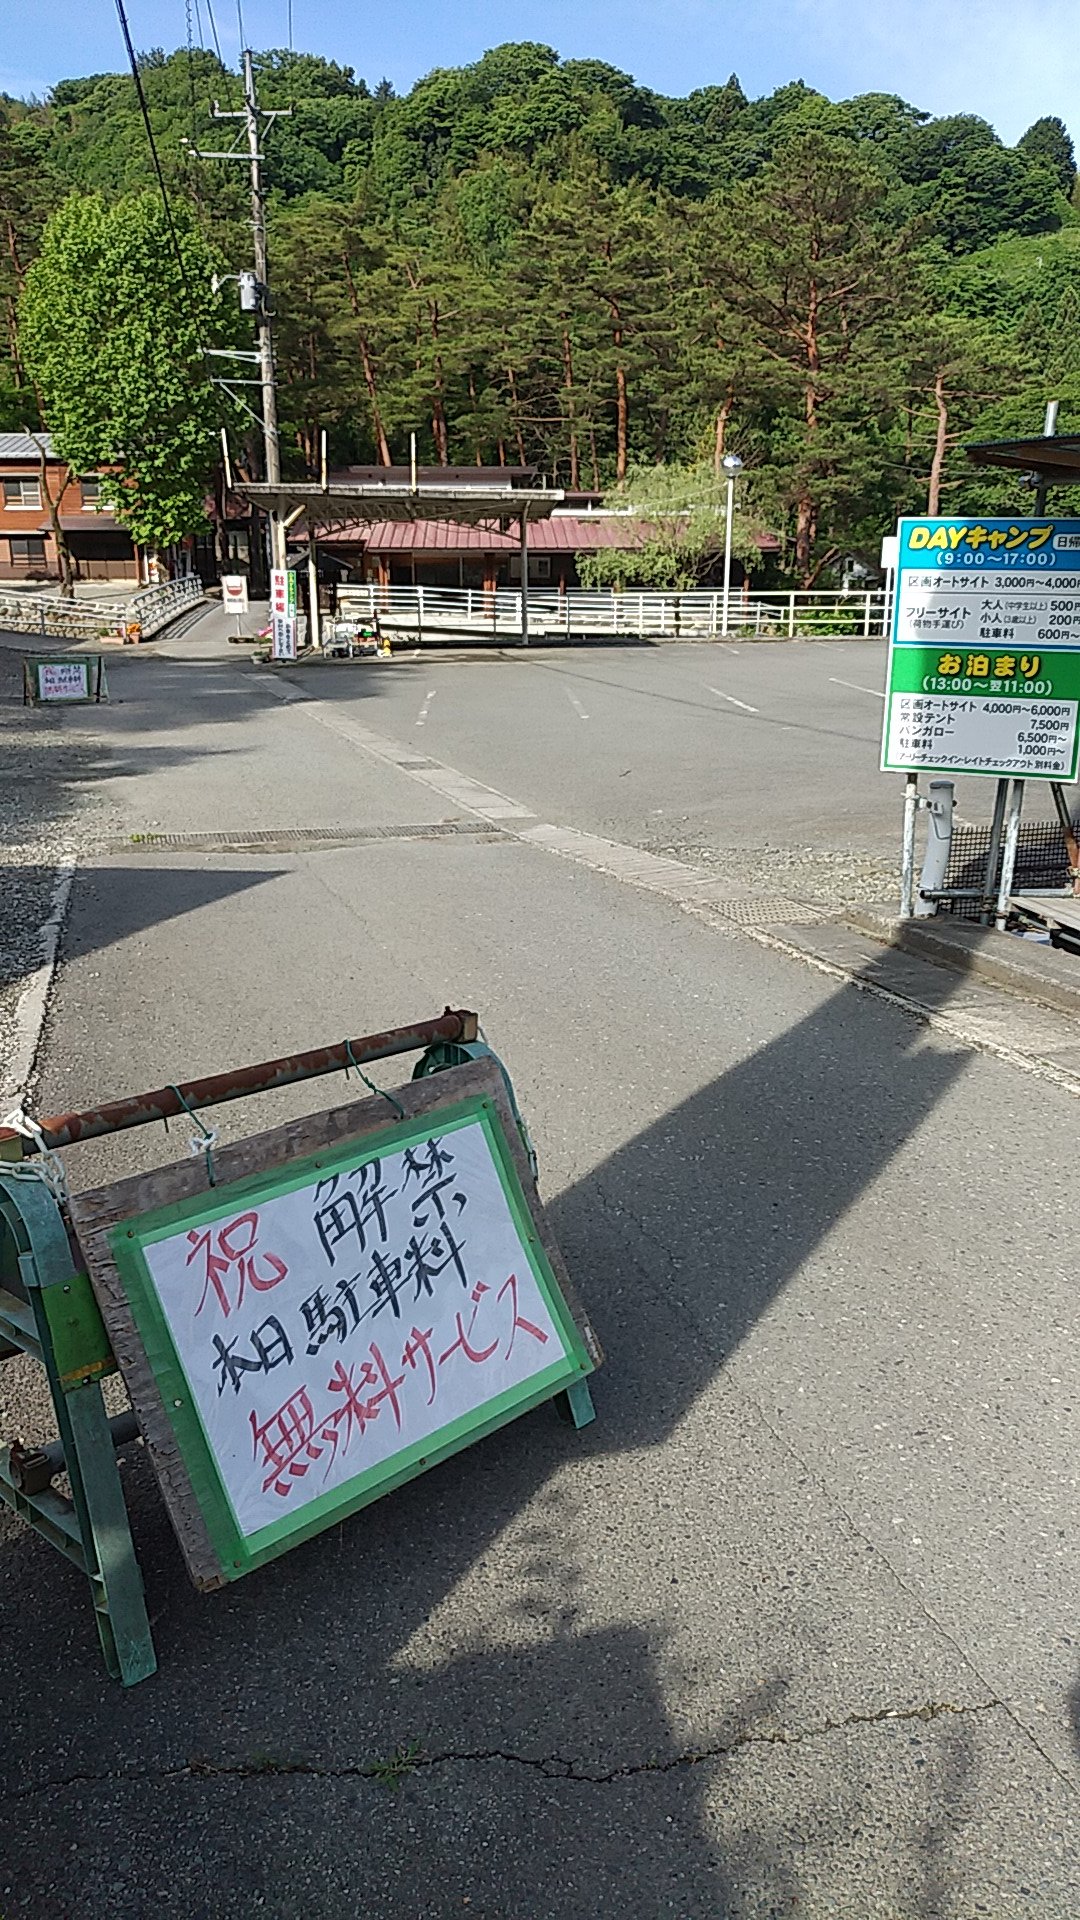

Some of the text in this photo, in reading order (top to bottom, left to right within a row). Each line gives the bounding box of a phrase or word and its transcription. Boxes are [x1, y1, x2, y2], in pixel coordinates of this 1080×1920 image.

[908, 524, 1054, 550] DAYキャンプ
[908, 575, 989, 589] 区画オートサイト
[906, 607, 971, 619] フリーサイト
[938, 654, 1040, 678] お泊まり
[899, 726, 955, 736] バンガロー
[1030, 719, 1070, 731] 7,500円
[186, 1137, 468, 1318] 祝 解禁
[248, 1273, 549, 1498] 無料サービス
